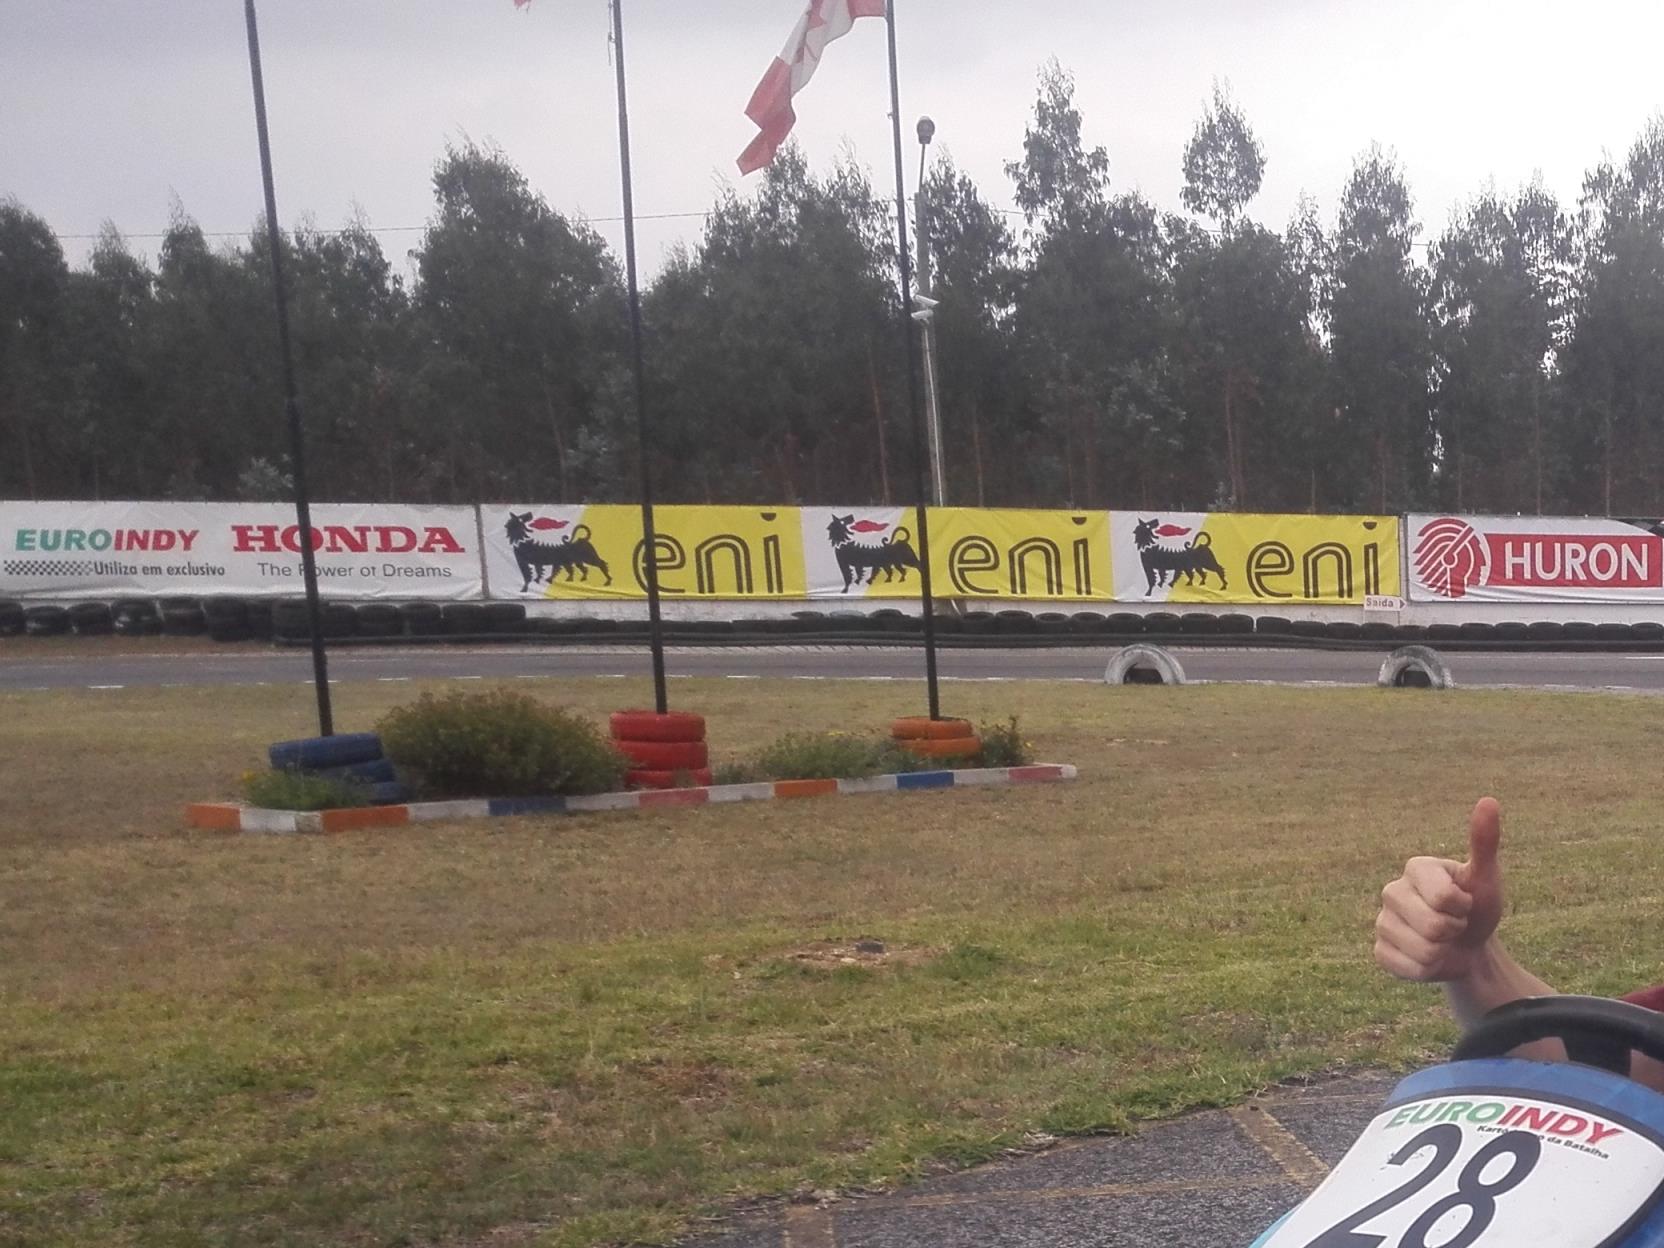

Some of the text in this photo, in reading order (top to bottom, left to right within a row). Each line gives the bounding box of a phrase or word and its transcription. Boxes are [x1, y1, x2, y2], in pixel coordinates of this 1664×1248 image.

[15, 529, 200, 551] EUROINDY
[231, 524, 466, 553] HONDA
[632, 512, 784, 594] eni
[948, 516, 1092, 595] eni
[94, 561, 225, 576] Utiliza em exclusivo
[258, 562, 292, 577] The
[360, 563, 377, 577] of
[383, 563, 452, 577] Dreams
[1246, 521, 1380, 598] eni
[1504, 541, 1648, 581] HURON
[1383, 1100, 1628, 1145] EUROINDY
[1547, 1135, 1562, 1145] da
[1563, 1139, 1609, 1160] Batalha
